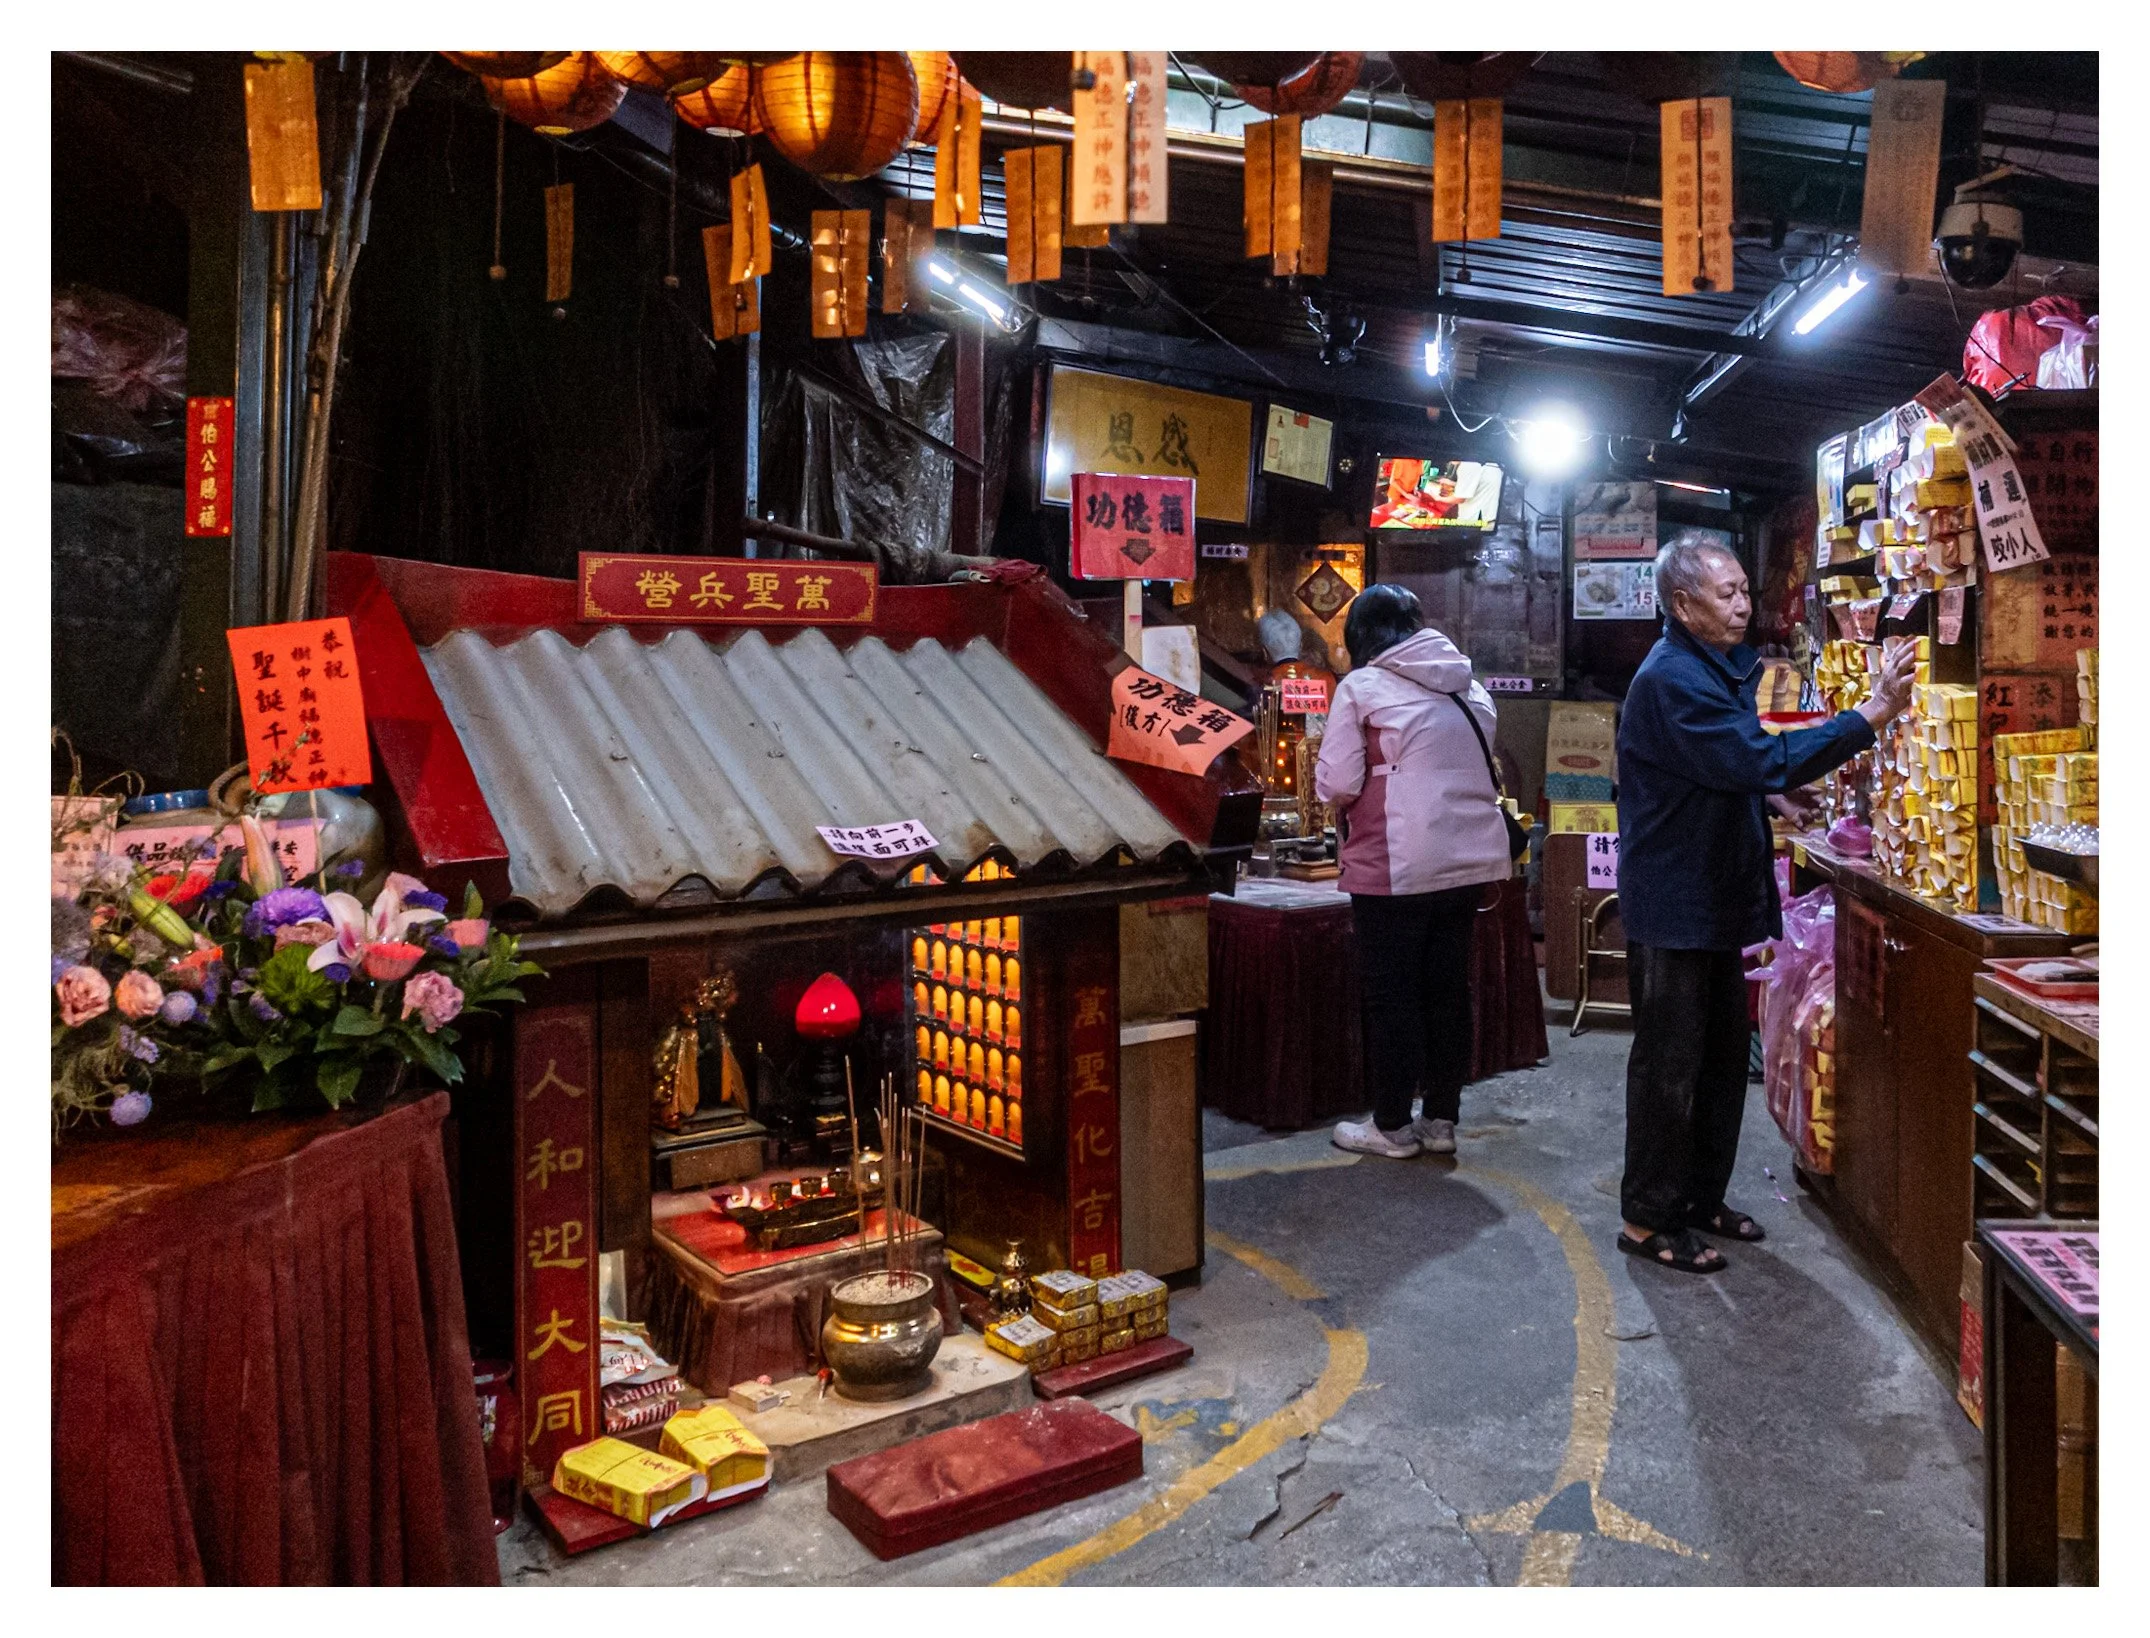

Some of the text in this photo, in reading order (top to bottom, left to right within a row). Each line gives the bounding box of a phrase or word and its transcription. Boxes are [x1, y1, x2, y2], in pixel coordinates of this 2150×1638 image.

[1086, 491, 1184, 536] 功德箱
[1636, 565, 1653, 579] 14
[1635, 591, 1652, 606] 15
[322, 629, 349, 680] 恭祝
[1128, 677, 1237, 733] 功德箱
[526, 1058, 588, 1446] 人和迎大同
